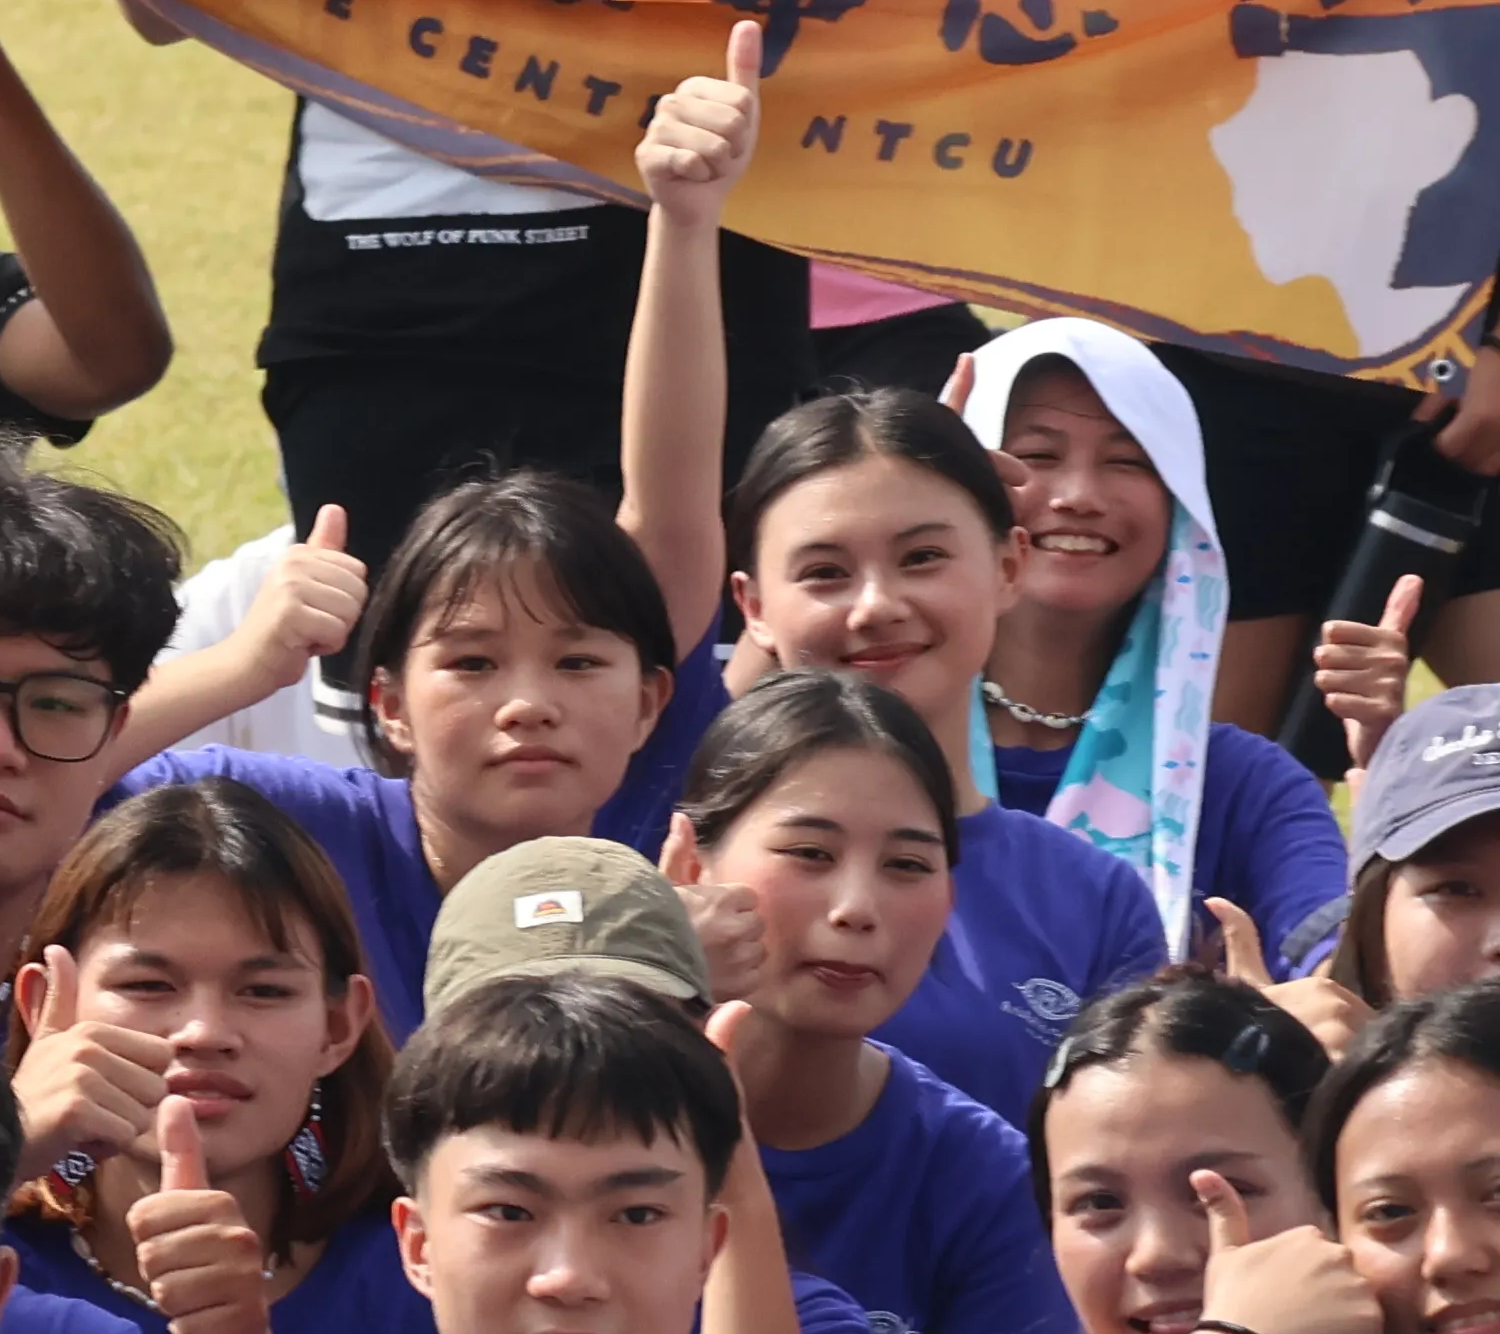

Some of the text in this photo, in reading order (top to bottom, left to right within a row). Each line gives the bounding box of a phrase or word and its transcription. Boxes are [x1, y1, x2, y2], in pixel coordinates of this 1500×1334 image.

[409, 17, 660, 129] CENT
[801, 114, 1033, 179] NTCU
[437, 229, 465, 244] OF
